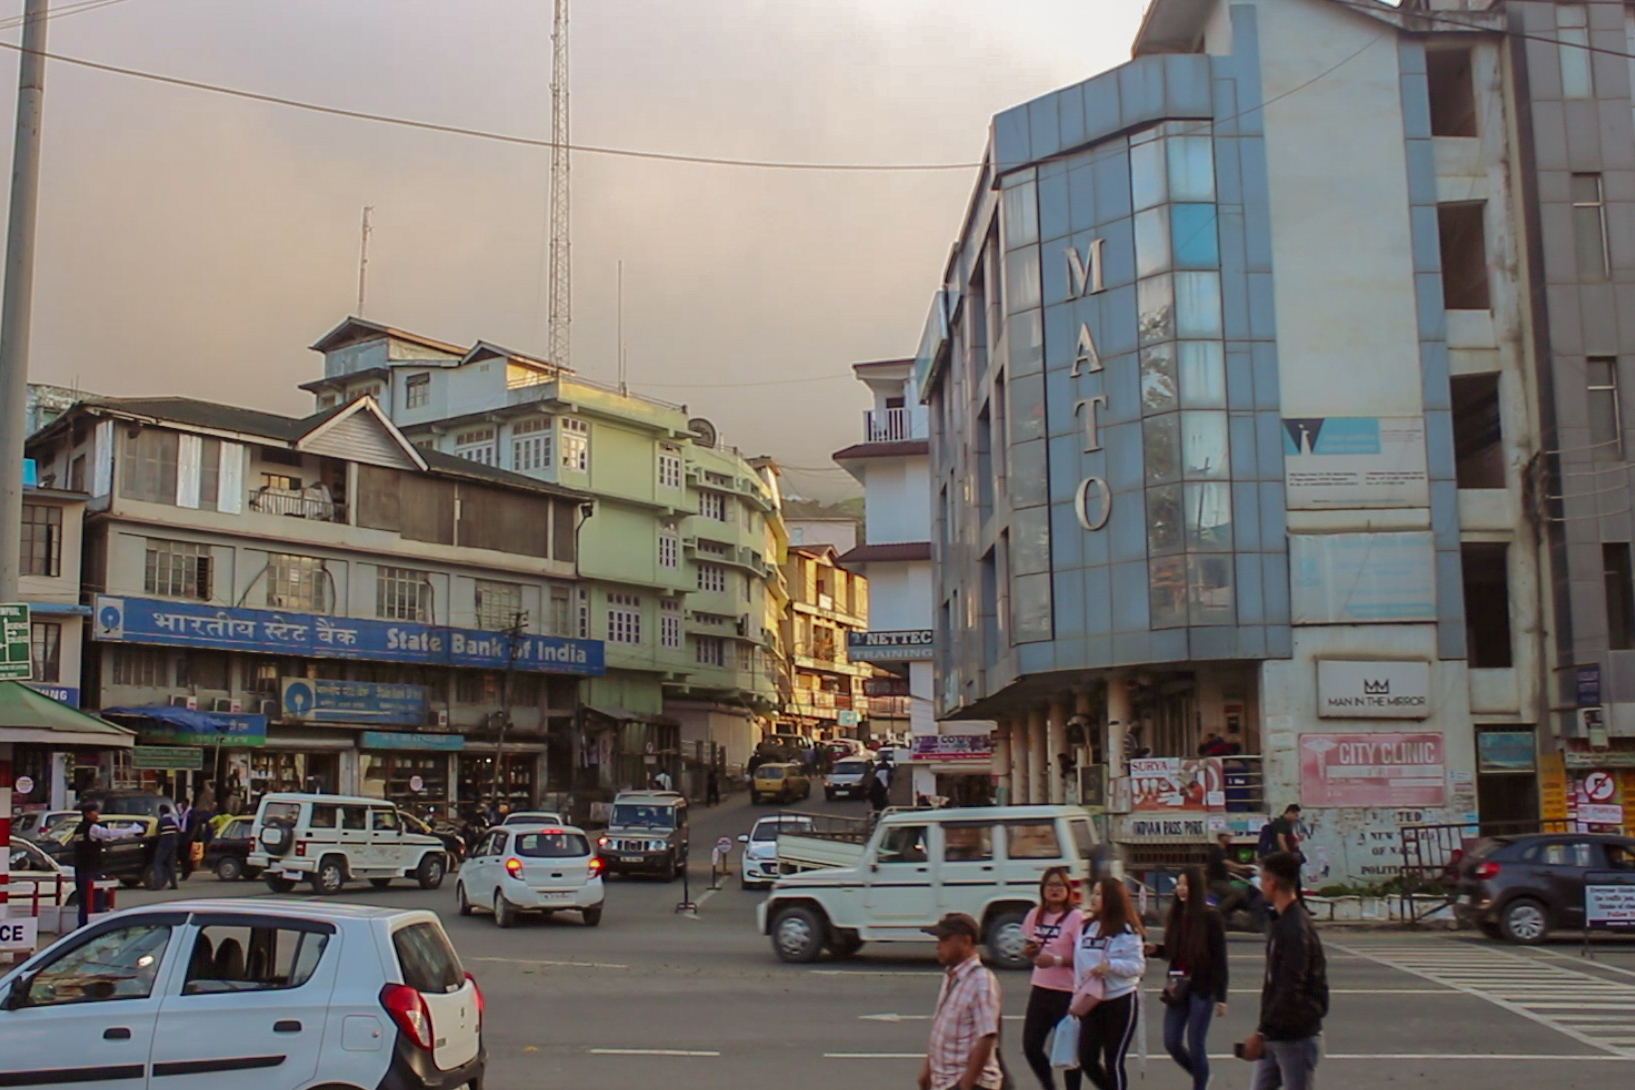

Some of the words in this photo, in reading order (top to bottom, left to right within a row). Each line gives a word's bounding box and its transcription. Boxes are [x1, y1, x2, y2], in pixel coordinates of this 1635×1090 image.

[153, 610, 257, 638] भारतीय
[264, 614, 310, 642] स्टेट
[314, 617, 359, 645] बैंक
[867, 631, 932, 645] NETTEC
[386, 627, 443, 652] State
[451, 633, 503, 658] Bank
[537, 640, 587, 664] India
[853, 648, 933, 659] TRAINING
[1328, 698, 1352, 707] MAN
[1355, 698, 1364, 706] IN
[1366, 697, 1385, 706] THE
[1387, 696, 1425, 706] MIRROR
[1339, 742, 1376, 764] CITY
[1381, 741, 1435, 764] CLINIC
[1131, 761, 1168, 772] SURYA
